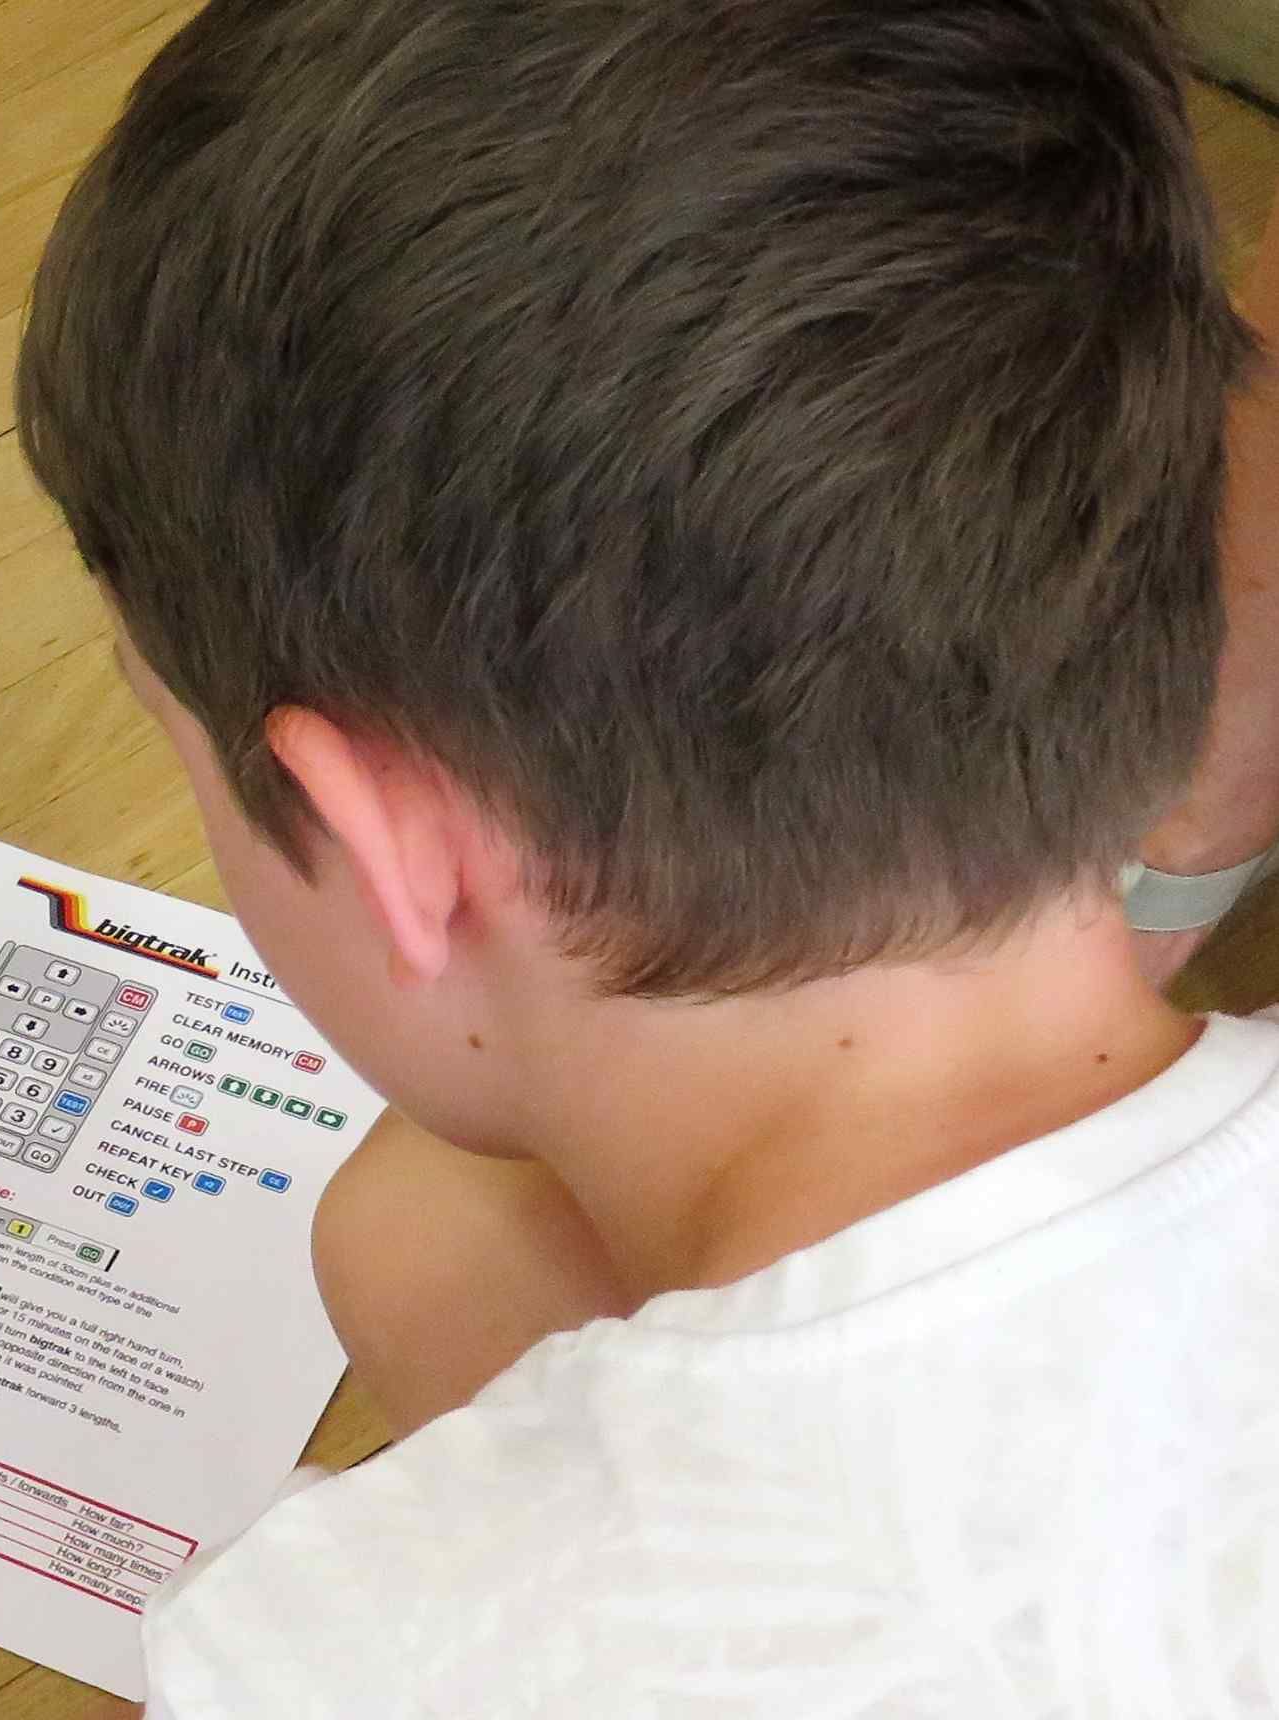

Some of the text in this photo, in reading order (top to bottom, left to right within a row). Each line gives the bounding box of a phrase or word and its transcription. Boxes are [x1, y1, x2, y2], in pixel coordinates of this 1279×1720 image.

[94, 918, 211, 967] bigtrak
[186, 992, 224, 1011] TEST
[160, 1034, 184, 1049] GO
[172, 1014, 223, 1037] CLEAR
[226, 1031, 294, 1060] MEMORY
[7, 1046, 22, 1059] 8
[42, 1058, 57, 1071] 9
[147, 1056, 215, 1085] ARROWS
[26, 1084, 41, 1097] 6
[135, 1076, 171, 1095] FIRE
[10, 1109, 26, 1123] 3
[123, 1097, 174, 1122] PAUSE
[111, 1120, 259, 1176] CANCEL LAST STEP
[97, 1141, 193, 1181] REPEAT KEY
[85, 1163, 139, 1189] CHECK
[72, 1185, 106, 1202] OUT
[17, 1225, 25, 1234] 1
[13, 1311, 27, 1322] 15
